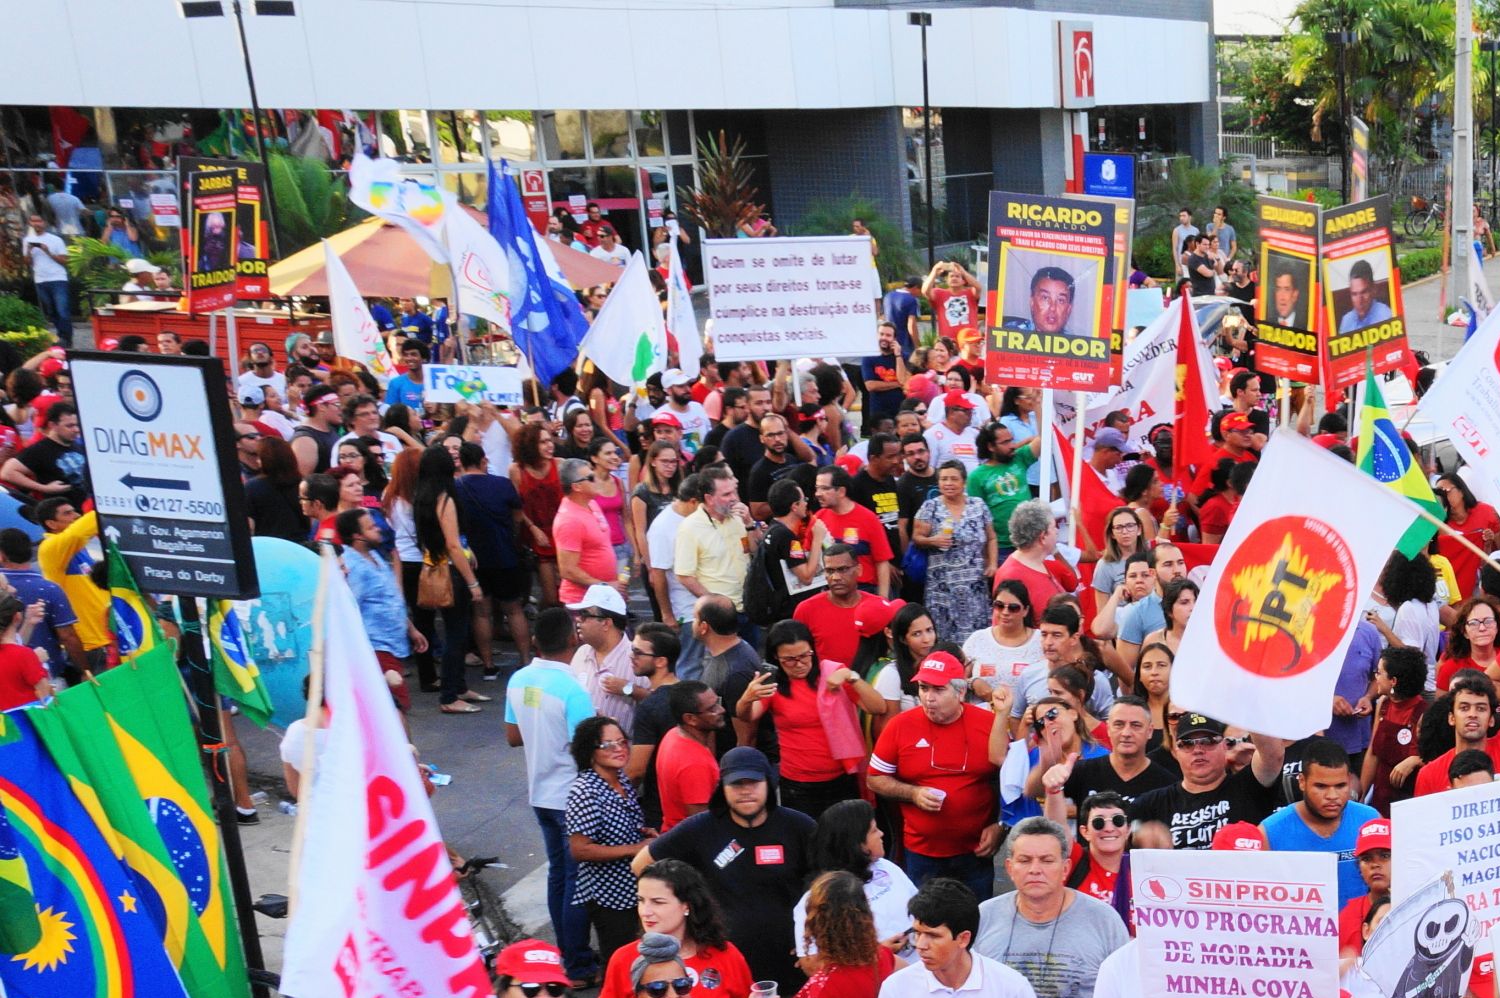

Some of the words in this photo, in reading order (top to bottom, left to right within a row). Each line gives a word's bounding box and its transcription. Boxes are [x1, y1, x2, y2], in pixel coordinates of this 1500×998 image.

[1008, 202, 1102, 227] RICARDO
[1325, 207, 1376, 234] ANDRE
[1019, 218, 1087, 232] TEOBALDO
[711, 256, 744, 269] Quem
[752, 258, 765, 268] se
[772, 254, 804, 268] omite
[812, 254, 825, 266] de
[832, 253, 858, 265] lutar
[192, 269, 237, 288] TRAIDOR
[713, 284, 732, 297] por
[736, 282, 762, 293] seus
[766, 279, 808, 292] direitos
[816, 279, 862, 291] torna-se
[716, 304, 768, 321] cúmplice
[772, 307, 785, 317] na
[789, 302, 848, 319] destruição
[853, 302, 871, 313] das
[718, 329, 780, 345] conquistas
[785, 328, 827, 341] sociais.
[992, 330, 1106, 359] TRAIDOR
[1258, 324, 1316, 352] TRAIDOR
[1328, 319, 1403, 356] TRAIDOR
[1072, 371, 1095, 382] CUT
[93, 427, 206, 461] DIAGMAX
[97, 495, 133, 508] DERBY
[150, 497, 222, 516] 2127-5500
[132, 524, 147, 537] Av.
[150, 525, 171, 537] Gov.
[174, 528, 225, 541] Agamenon
[153, 539, 205, 553] Magalhães
[145, 566, 173, 581] Praça
[178, 569, 191, 580] do
[195, 570, 225, 585] Derby
[1171, 800, 1230, 826] RESISTIR
[1172, 831, 1181, 846] E
[1235, 838, 1258, 848] CUT
[1439, 827, 1474, 846] PISO
[1189, 881, 1323, 903] SINPROJA
[1136, 907, 1199, 929] NOVO
[1205, 912, 1339, 937] PROGRAMA
[1164, 940, 1194, 964] DE
[1200, 942, 1314, 969] MORADIA
[1166, 975, 1247, 996] MINHA
